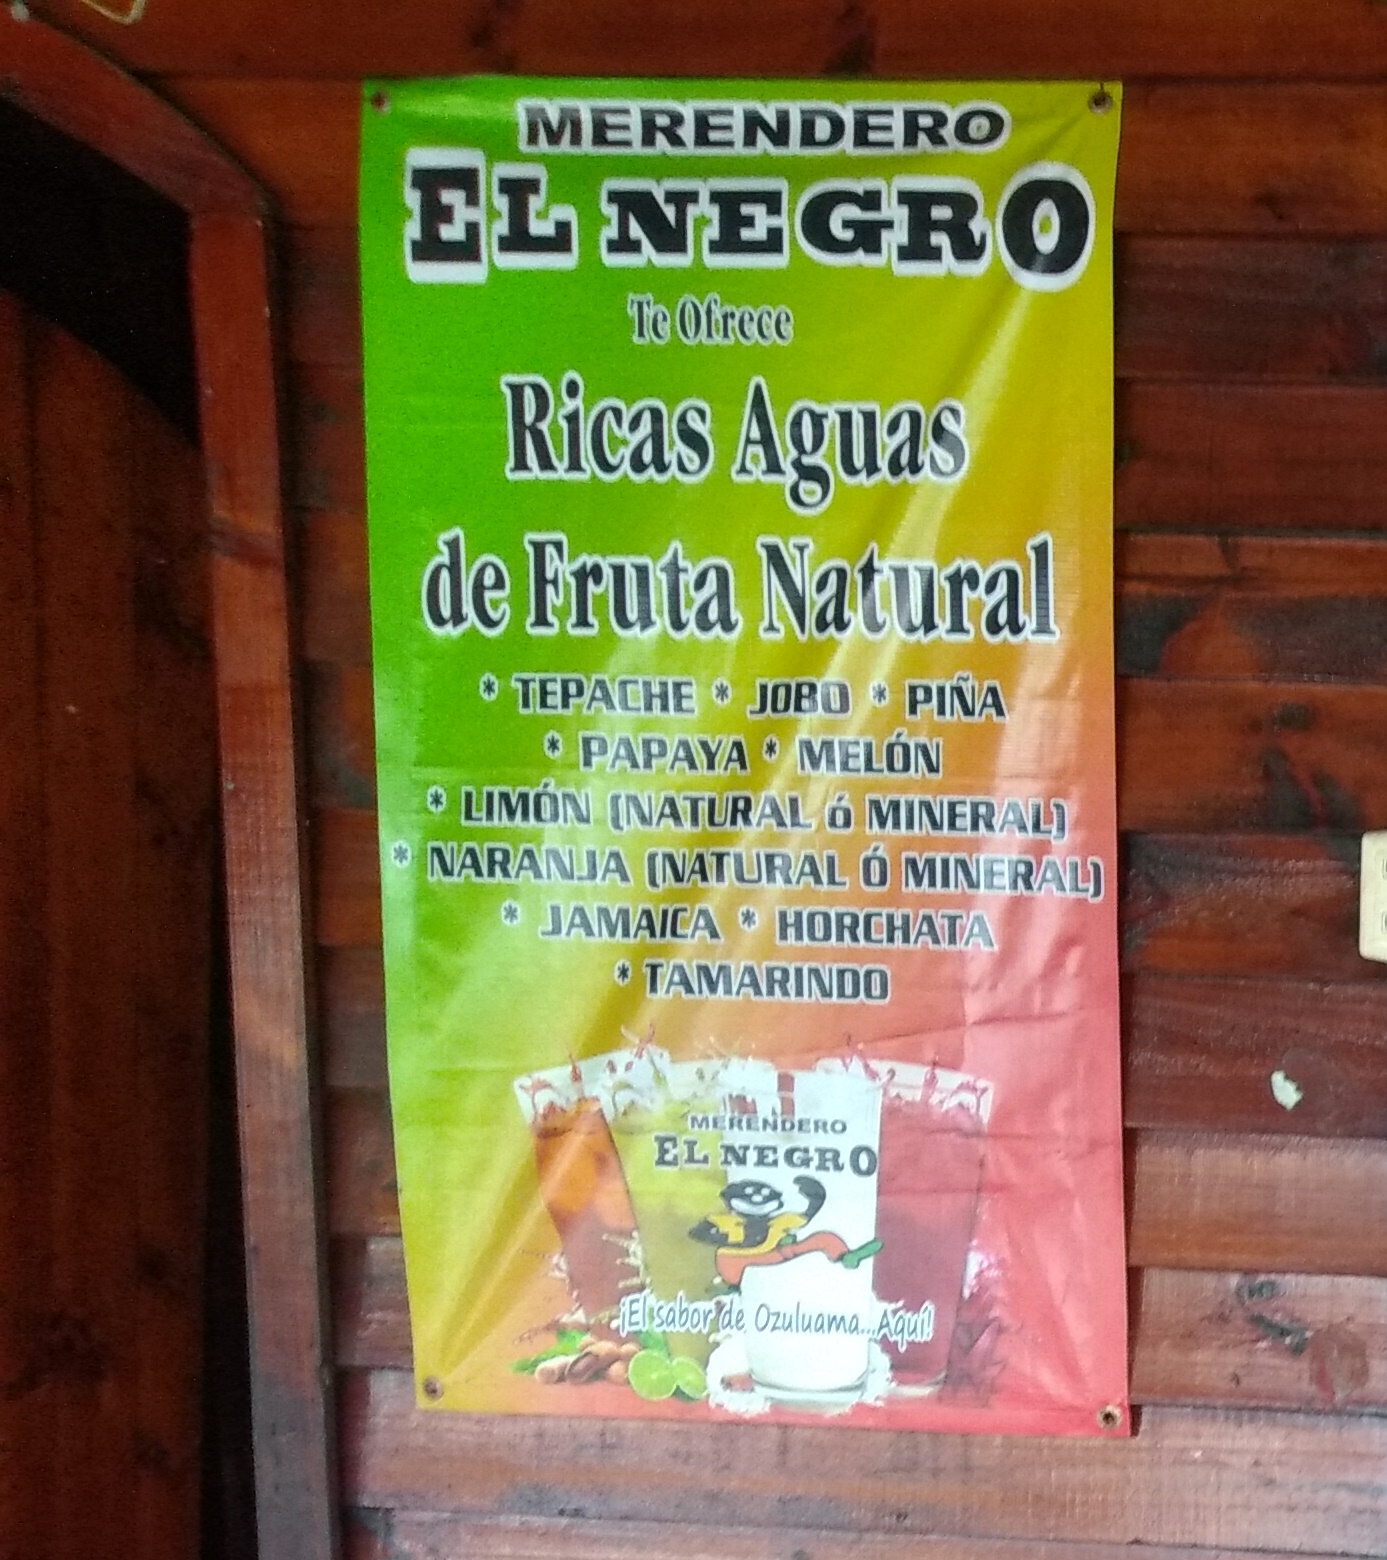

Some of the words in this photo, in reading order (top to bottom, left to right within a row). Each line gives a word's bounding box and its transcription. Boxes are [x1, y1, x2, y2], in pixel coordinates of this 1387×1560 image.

[525, 104, 1008, 150] MERENDERO
[409, 164, 573, 266] EL
[604, 177, 1092, 275] NEGRO
[631, 296, 668, 343] Te
[679, 295, 792, 343] Ofrece
[506, 375, 710, 480] Ricas
[734, 379, 967, 512] Aguas
[425, 532, 507, 633] de
[526, 535, 738, 637] Fruta
[760, 535, 1058, 642] Natural
[513, 677, 696, 715] TEPACHE
[747, 680, 851, 717] JOBO
[907, 674, 1008, 720] PIÑA
[580, 734, 748, 772] PAPAYA
[798, 730, 942, 776] MELÓN
[462, 780, 592, 824] LIMÓN
[610, 791, 814, 832] (NATURAL
[867, 798, 1068, 841] MINERAL)
[428, 844, 633, 885] NARANJA
[647, 847, 848, 890] (NATURAL
[861, 845, 889, 888] Ó
[903, 854, 1104, 899] MINERAL)
[540, 905, 722, 941] JAMAICA
[777, 909, 997, 949] HORCHATA
[644, 962, 890, 1002] TAMARINDO
[689, 1114, 848, 1135] MERENDERO
[653, 1134, 710, 1167] EL
[720, 1143, 878, 1178] NEGRO
[653, 1292, 717, 1331] sabor
[719, 1293, 746, 1331] de
